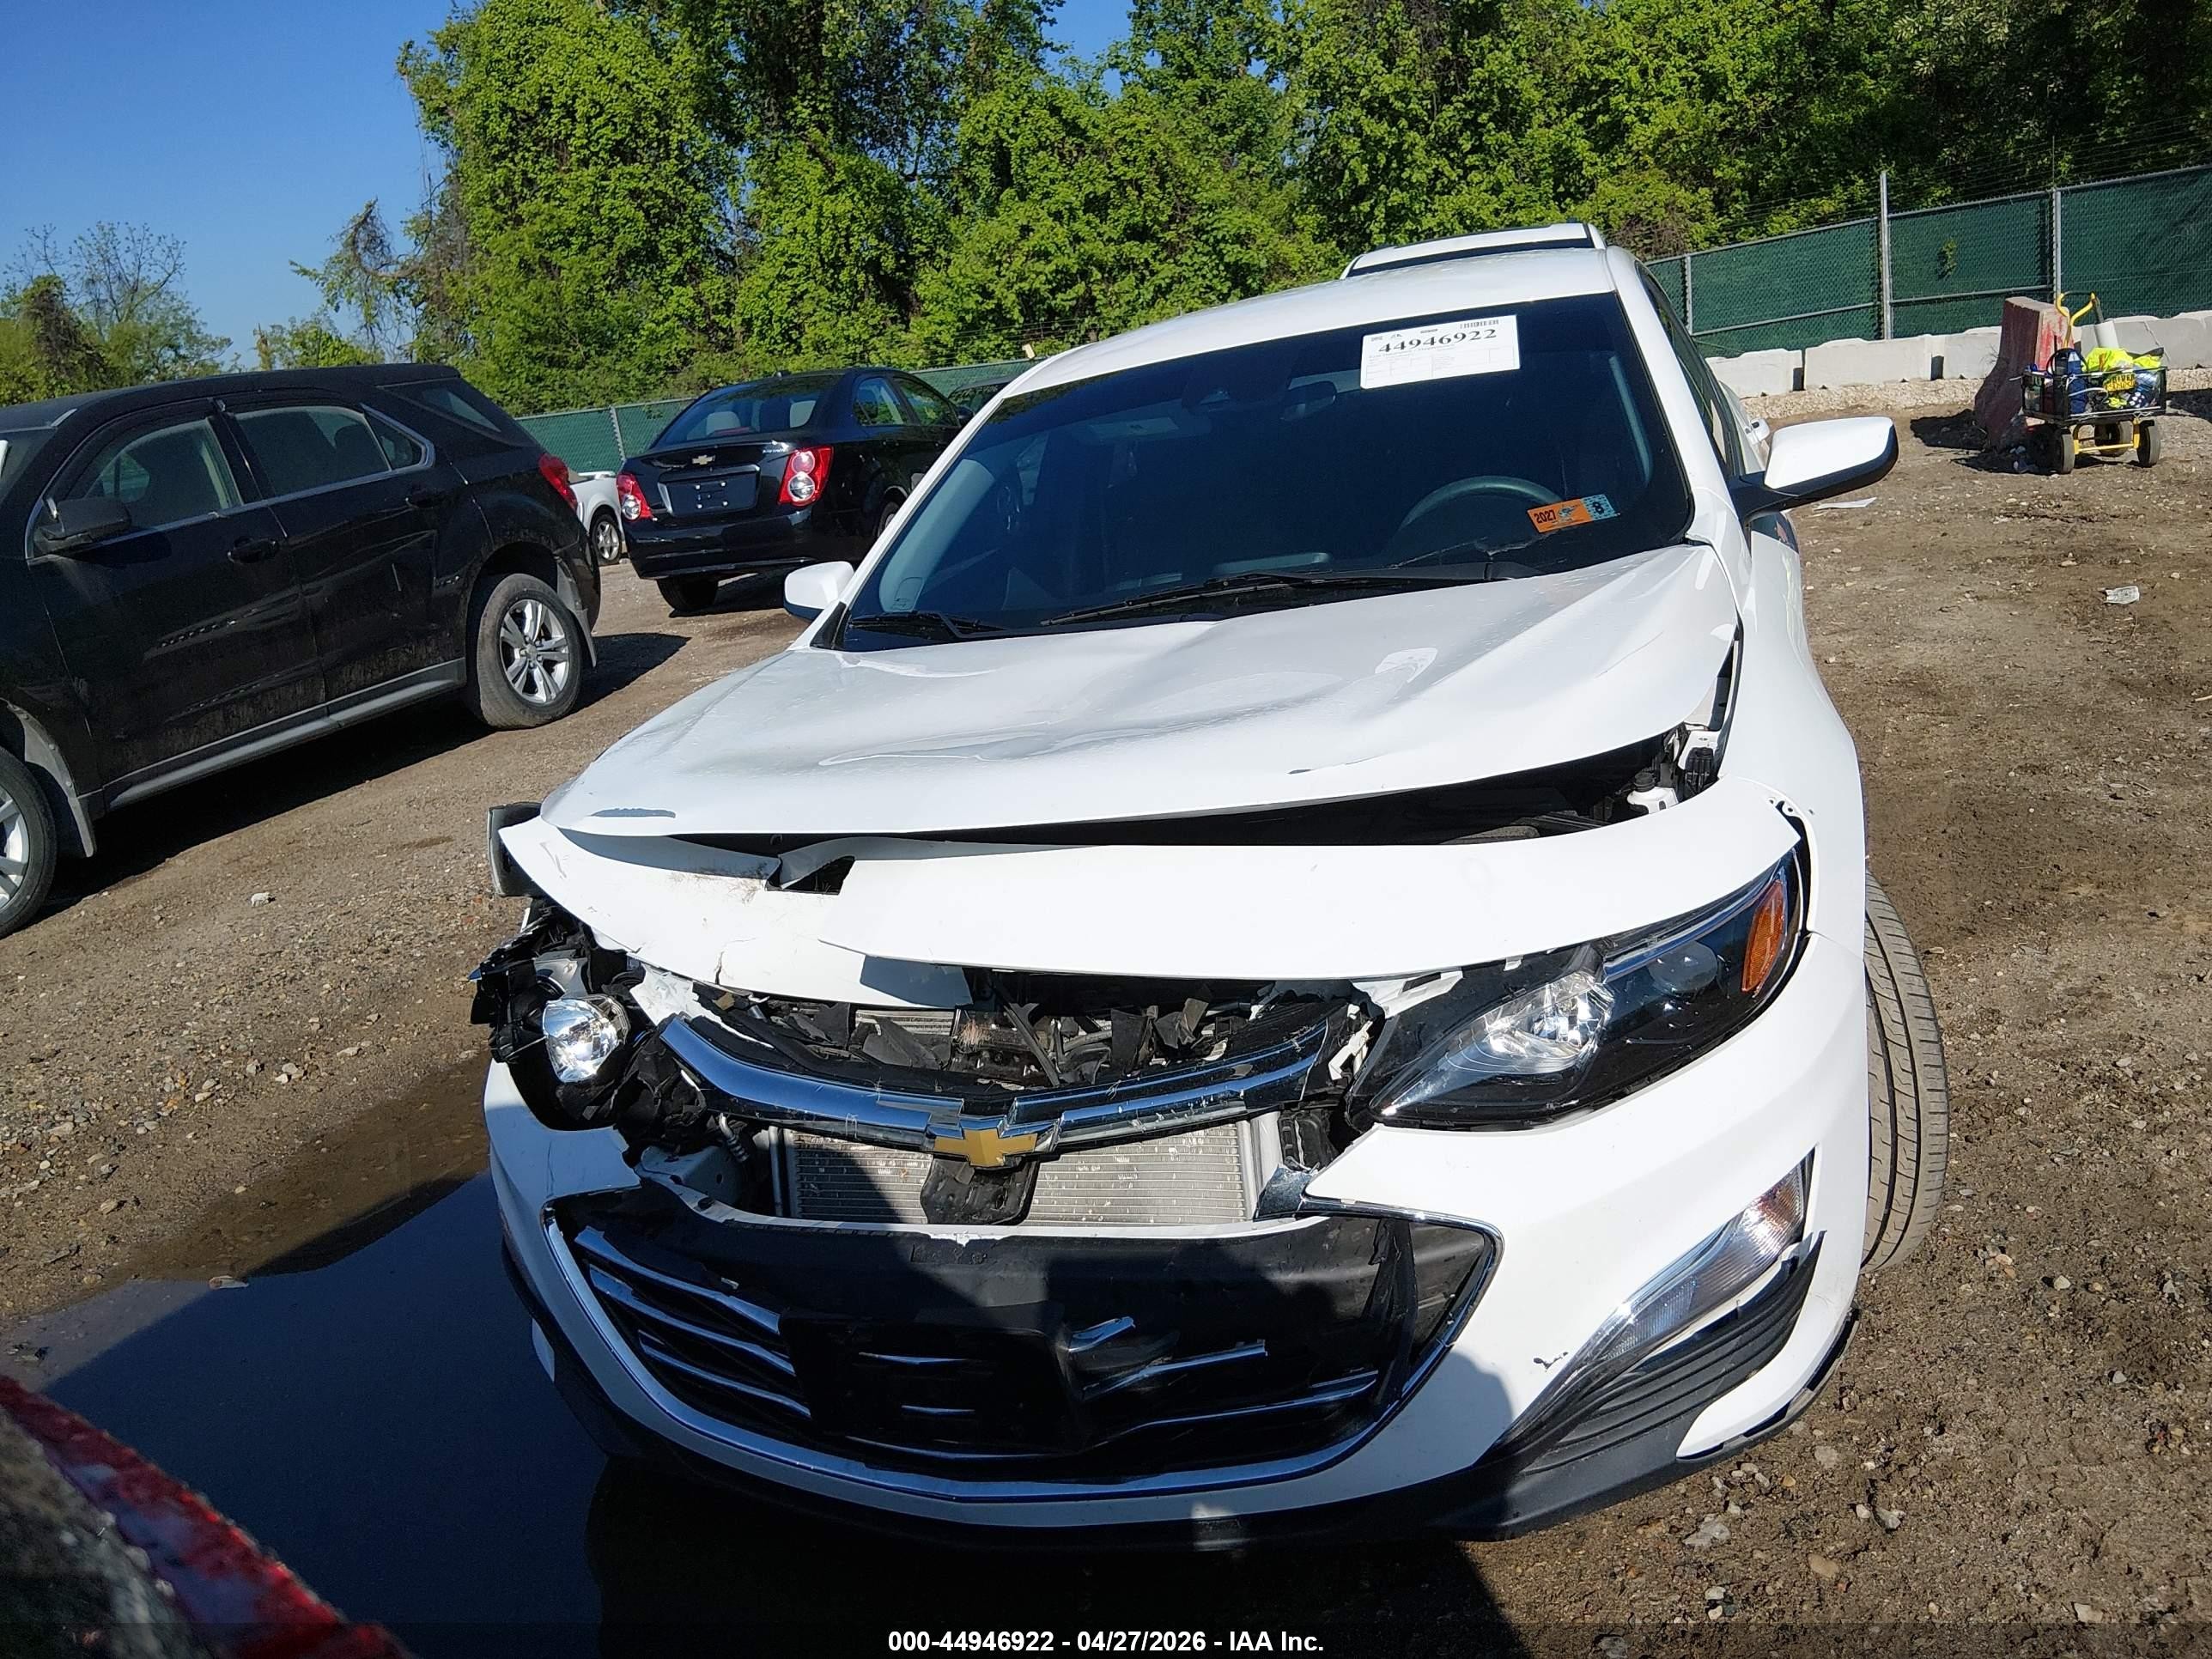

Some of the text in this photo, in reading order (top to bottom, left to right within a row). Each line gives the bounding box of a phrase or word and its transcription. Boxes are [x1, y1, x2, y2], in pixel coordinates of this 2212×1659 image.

[1378, 328, 1497, 353] 44946922
[1534, 509, 1556, 524] 2027
[1592, 501, 1605, 514] 8
